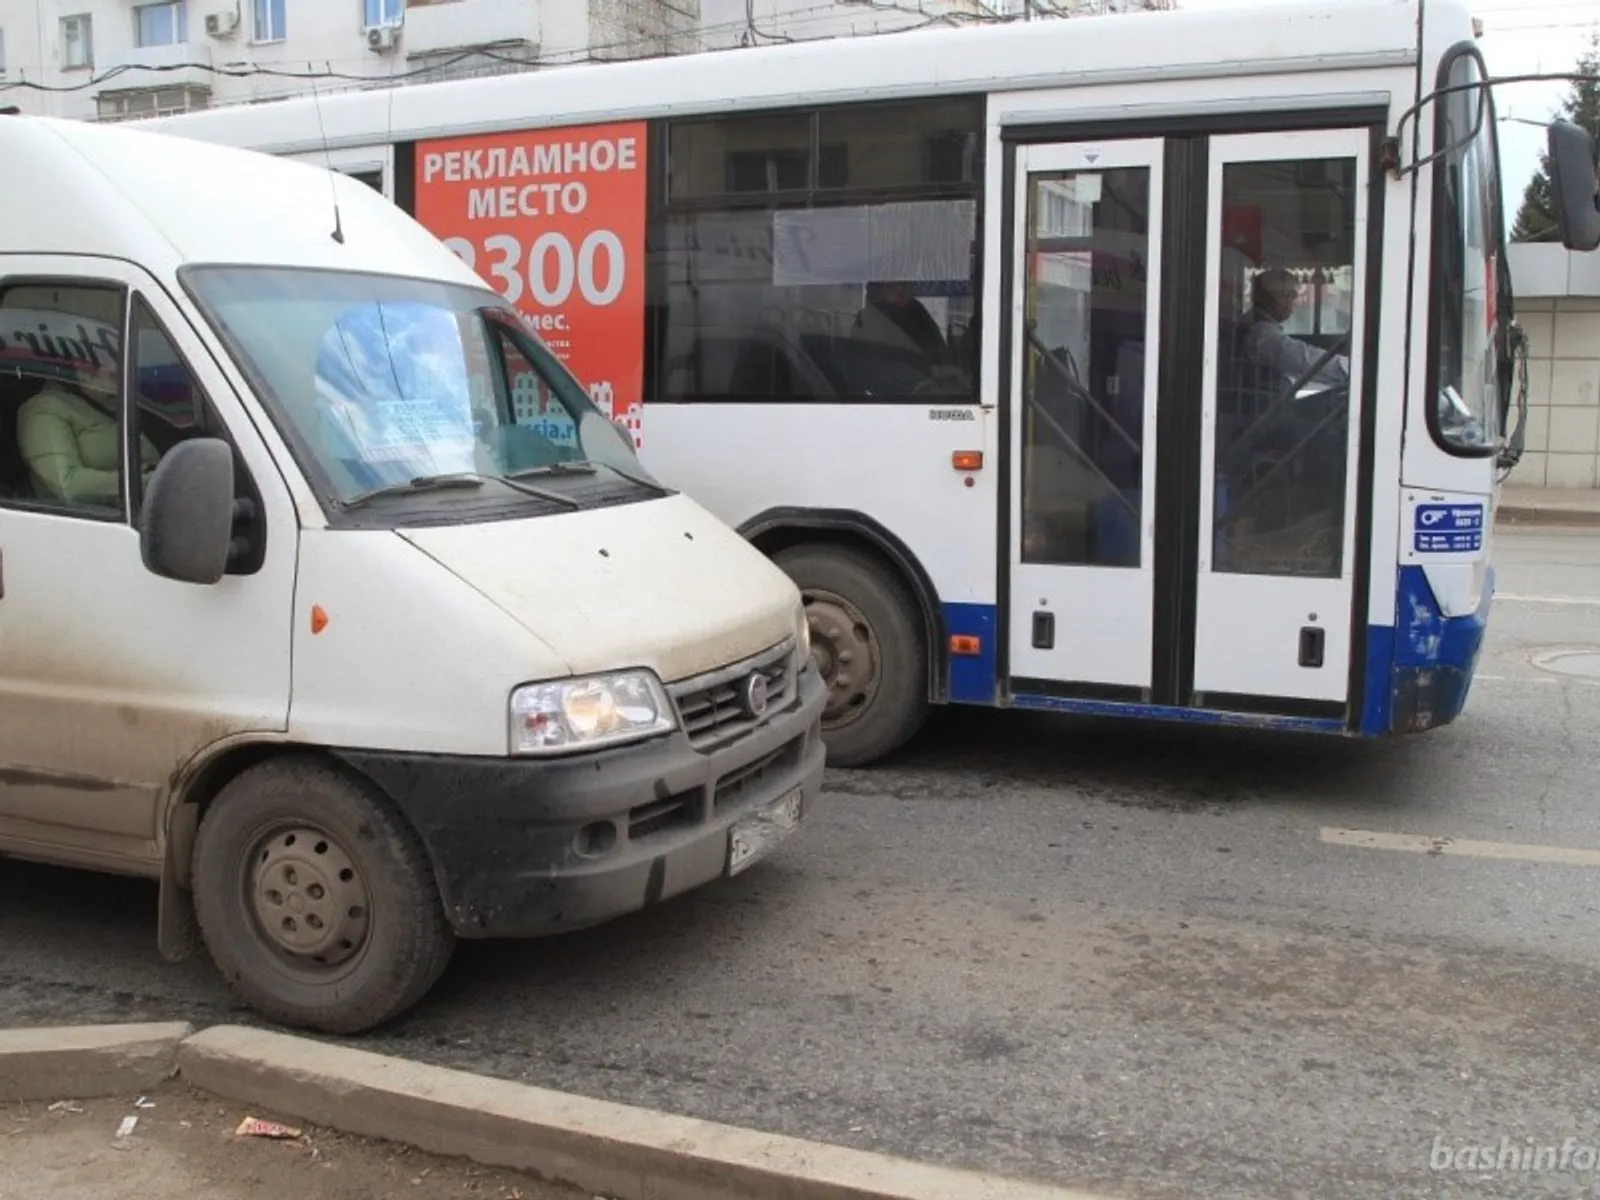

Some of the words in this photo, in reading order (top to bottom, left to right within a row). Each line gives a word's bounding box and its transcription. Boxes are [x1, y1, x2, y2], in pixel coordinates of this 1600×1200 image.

[423, 138, 637, 184] РЕКЛАМНОЕ
[467, 181, 588, 220] МЕСТО
[519, 310, 570, 330] мес.
